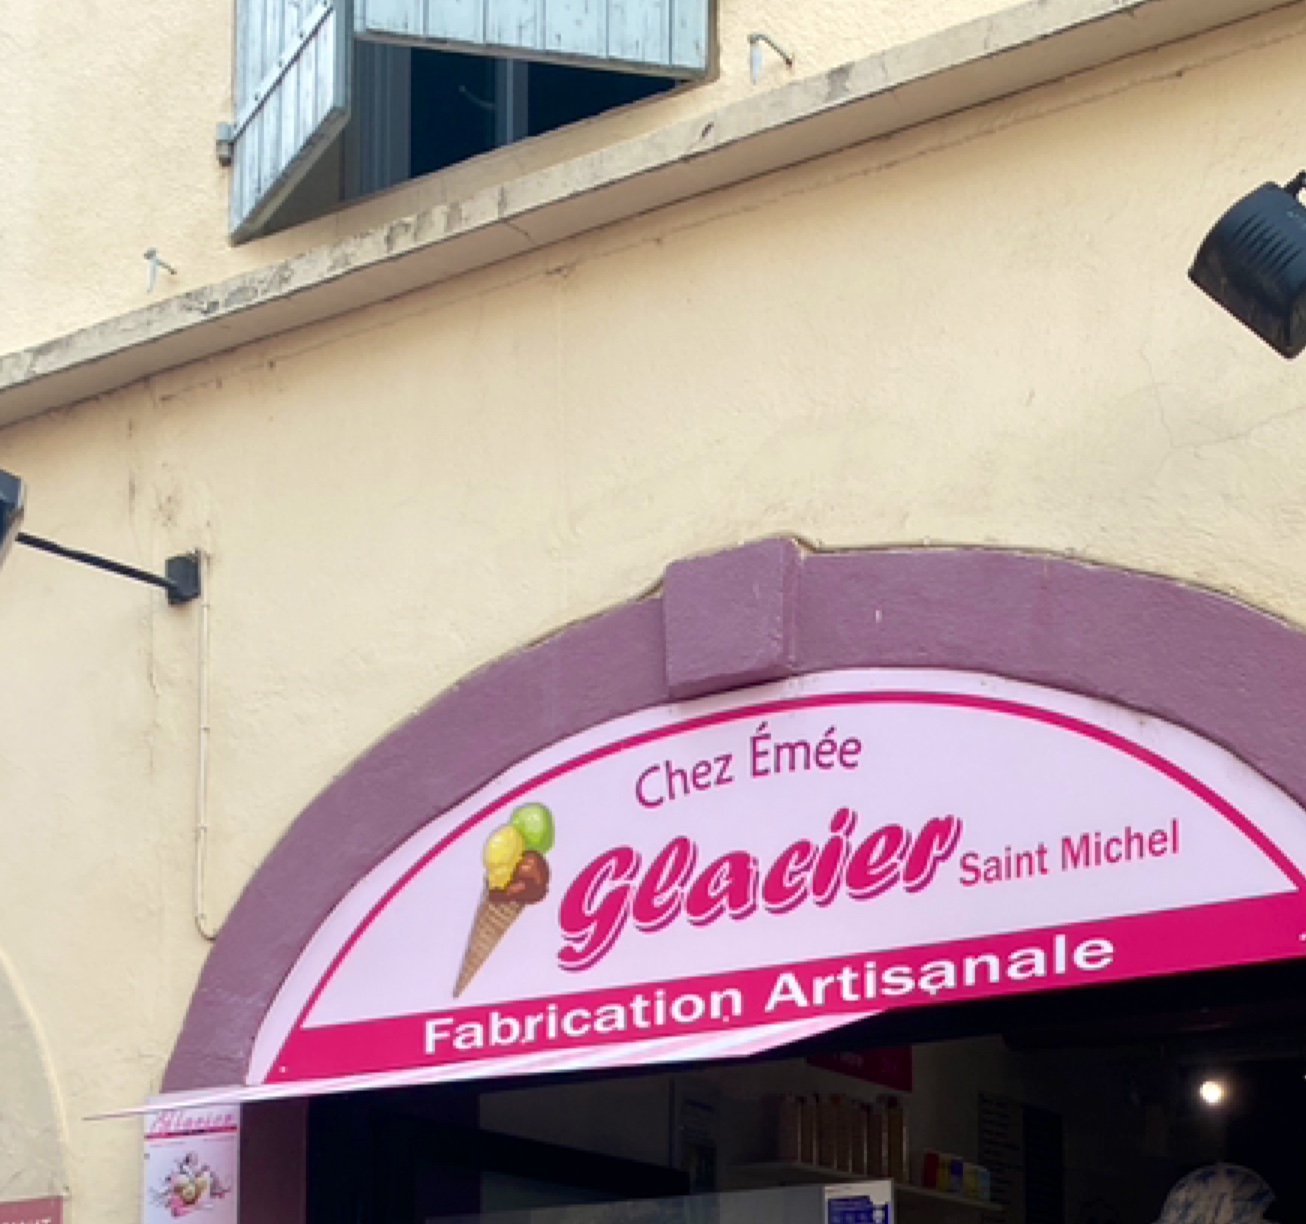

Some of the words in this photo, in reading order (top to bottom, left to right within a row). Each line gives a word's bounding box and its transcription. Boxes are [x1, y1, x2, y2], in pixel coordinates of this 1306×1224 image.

[635, 747, 734, 808] Chez
[749, 722, 862, 778] Émée
[558, 807, 963, 971] Glacier
[959, 842, 1048, 887] Saint
[1061, 819, 1180, 872] Michel
[424, 987, 743, 1055] Fabrication
[765, 934, 1115, 1013] Artisanale
